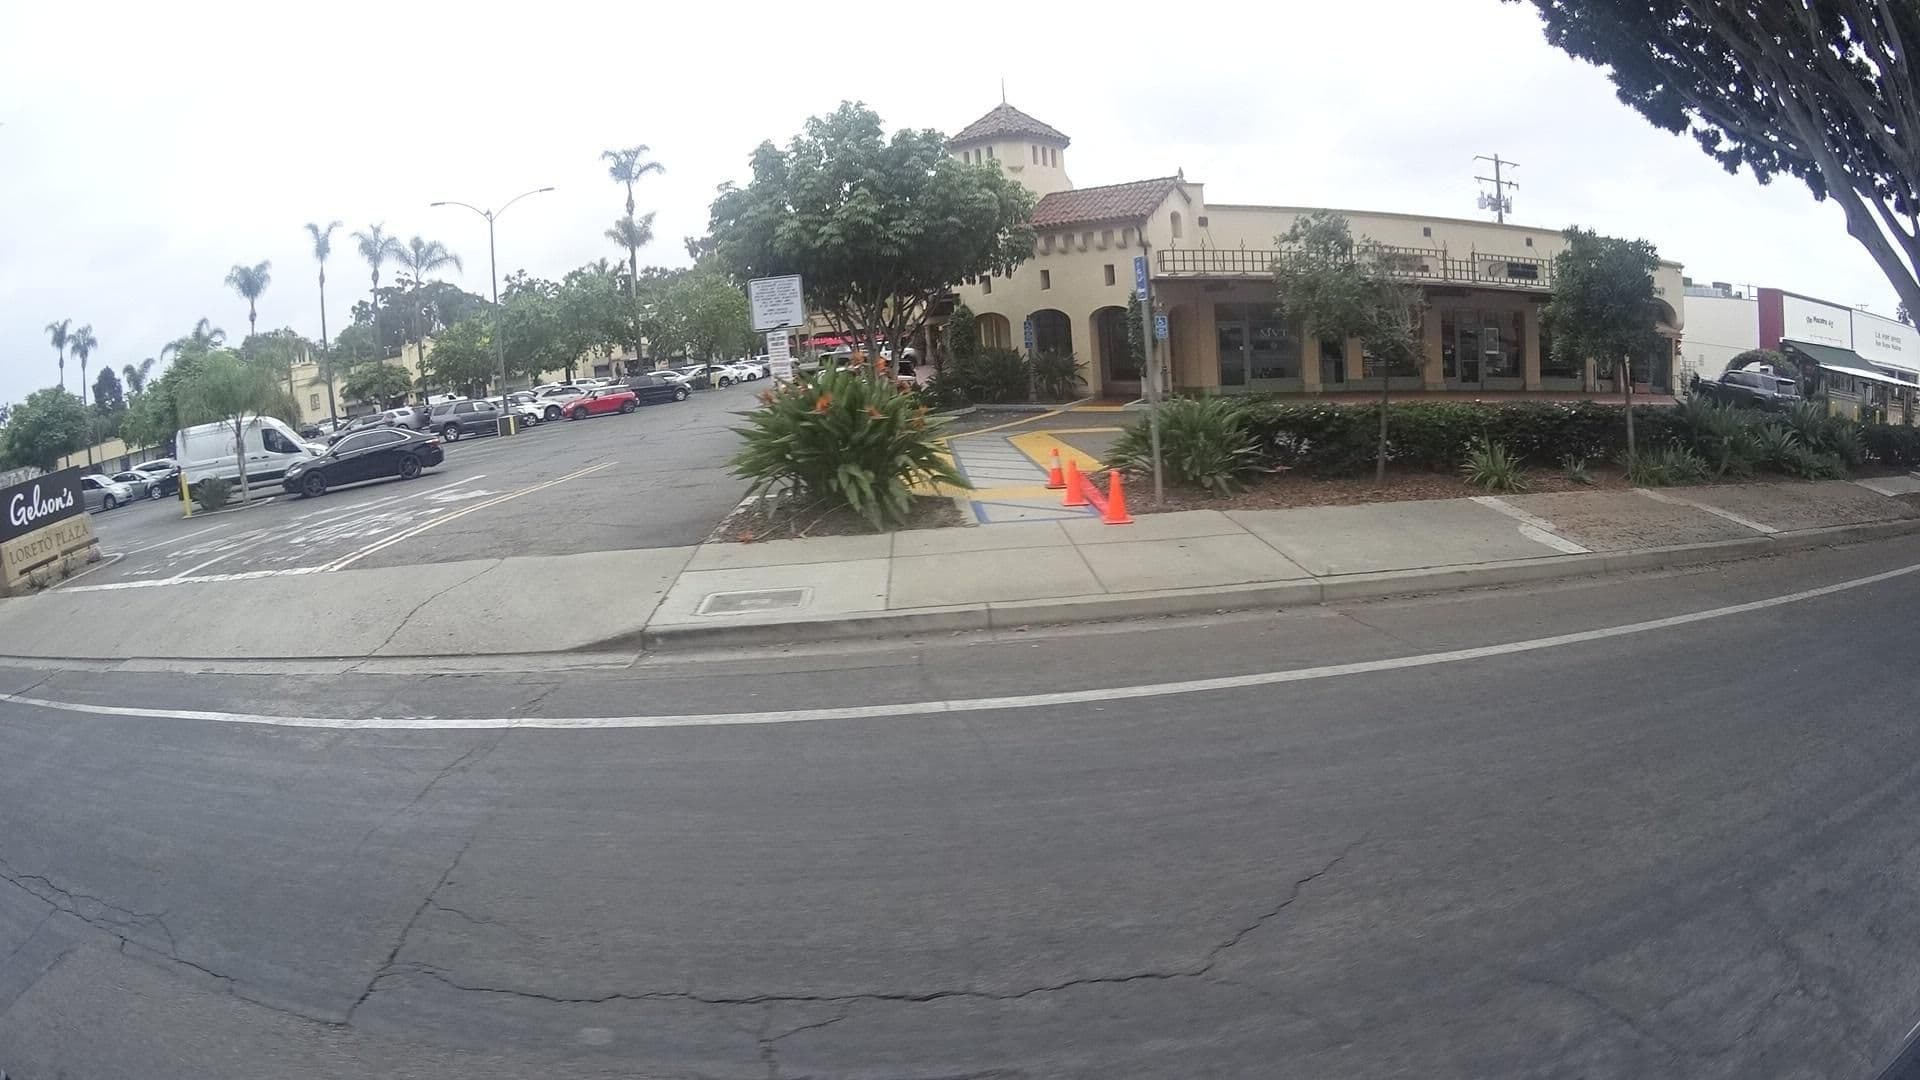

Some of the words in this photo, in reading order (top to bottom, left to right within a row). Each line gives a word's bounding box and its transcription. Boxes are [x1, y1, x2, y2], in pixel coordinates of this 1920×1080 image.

[10, 484, 74, 526] Gelson's
[9, 536, 52, 565] LORETO
[55, 523, 89, 546] PLAZA
